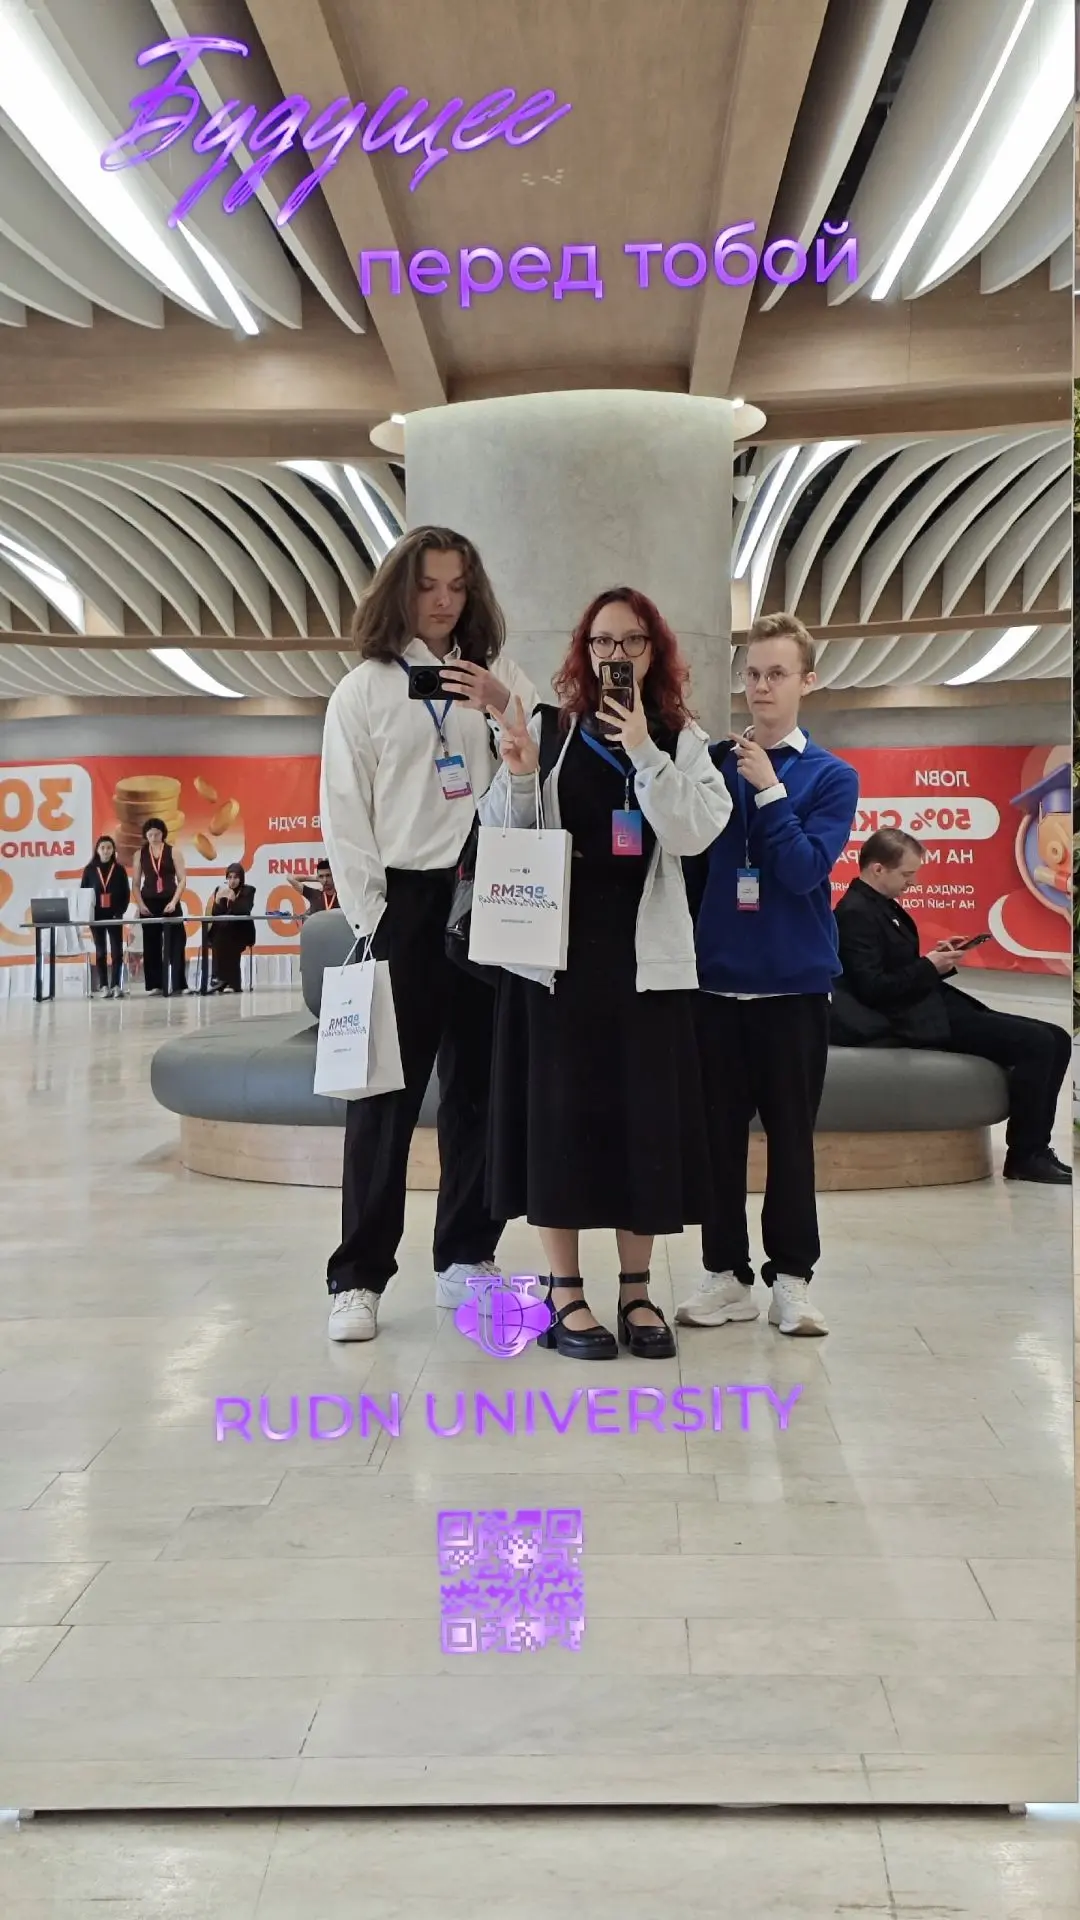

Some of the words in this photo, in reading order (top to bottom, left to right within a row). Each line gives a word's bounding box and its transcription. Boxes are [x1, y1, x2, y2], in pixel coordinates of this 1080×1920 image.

[101, 35, 573, 227] Будущее
[359, 243, 605, 309] перед
[623, 219, 860, 289] тобой
[214, 1393, 401, 1443] RUDN
[425, 1384, 804, 1438] UNIVERSITY
